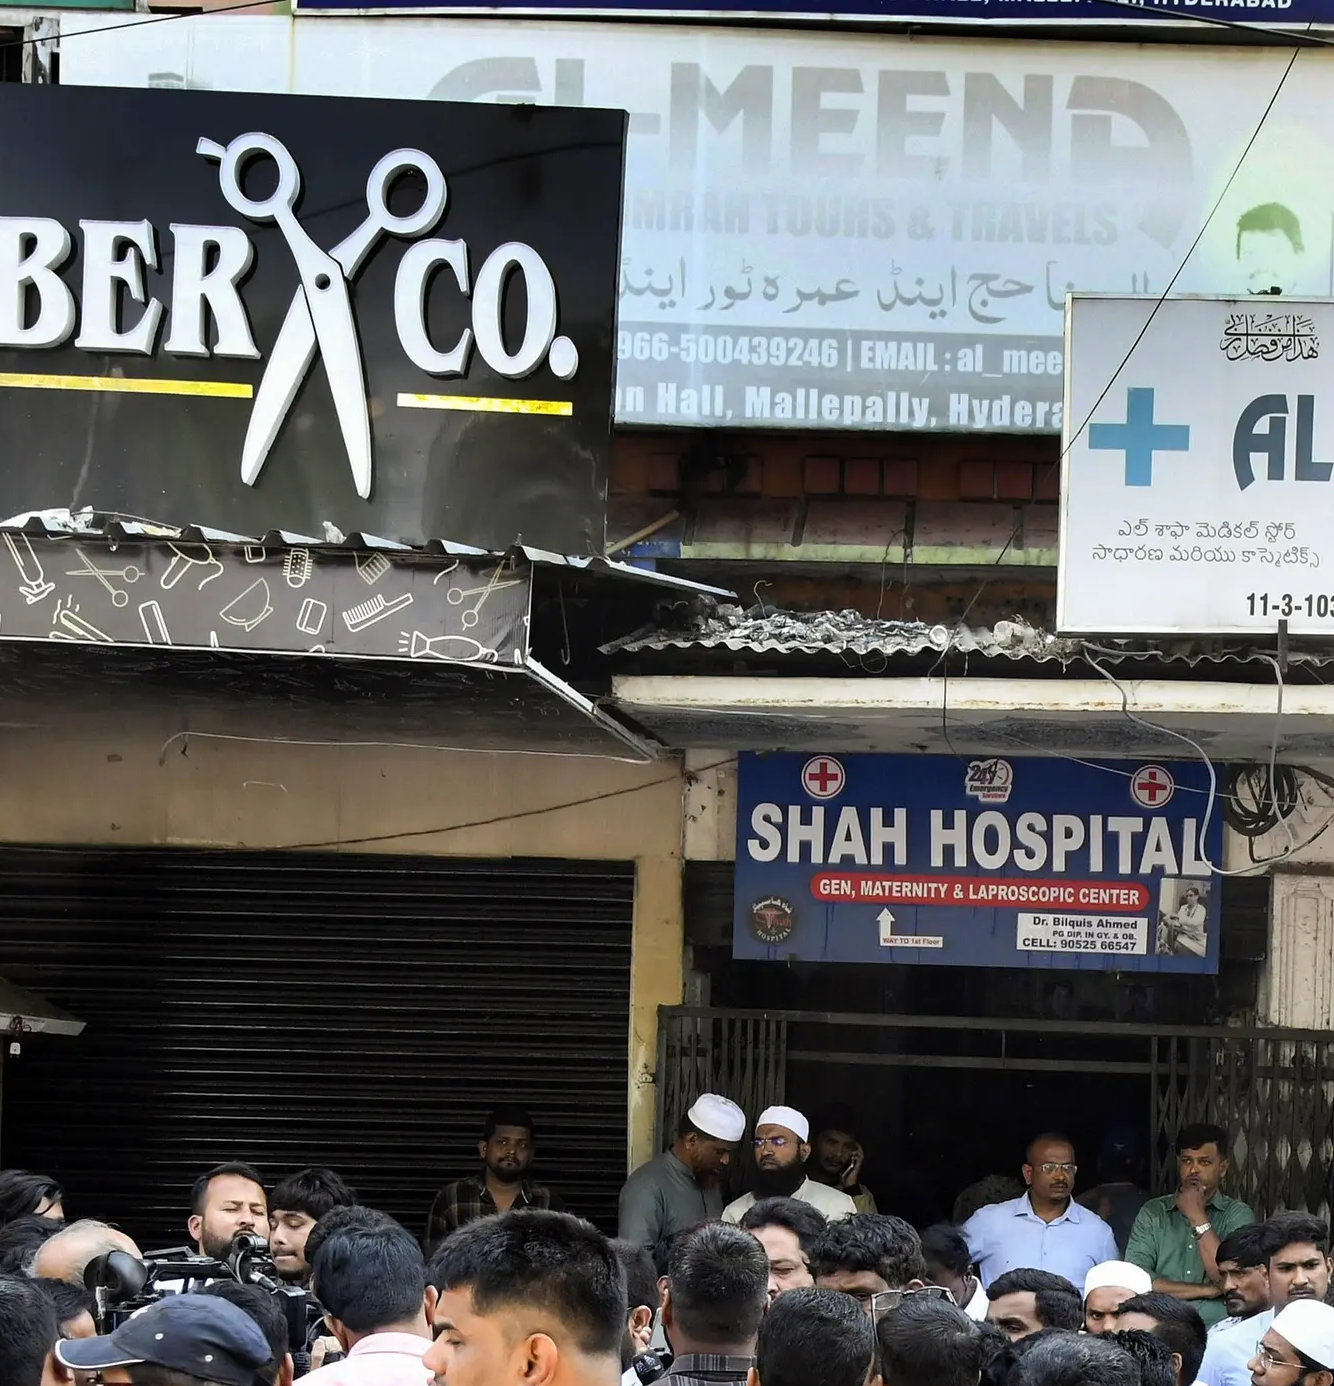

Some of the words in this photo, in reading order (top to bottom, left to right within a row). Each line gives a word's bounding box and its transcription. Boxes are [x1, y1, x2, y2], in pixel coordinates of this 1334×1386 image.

[625, 193, 751, 236] MRAH
[945, 202, 1117, 246] TRAVELS
[394, 238, 579, 381] CO.
[861, 340, 938, 371] EMAIL
[657, 382, 732, 421] Hall,
[745, 386, 937, 429] Mallepally,
[1233, 394, 1334, 491] AL
[747, 803, 907, 865] SHAH
[930, 807, 1212, 876] HOSPITAL
[819, 878, 856, 898] GEN,
[860, 880, 949, 900] MATERNITY
[953, 884, 964, 899] &
[968, 886, 1075, 905] LAPROSCOPIC
[1079, 889, 1140, 905] CENTER
[883, 937, 898, 945] WAY
[899, 937, 910, 945] TO
[1033, 916, 1048, 926] Dr.
[1053, 917, 1093, 929] Bilquis
[1097, 919, 1138, 929] Ahmed
[1023, 938, 1056, 948] CELL:
[1061, 940, 1097, 949] 90525
[1100, 941, 1137, 951] 66547
